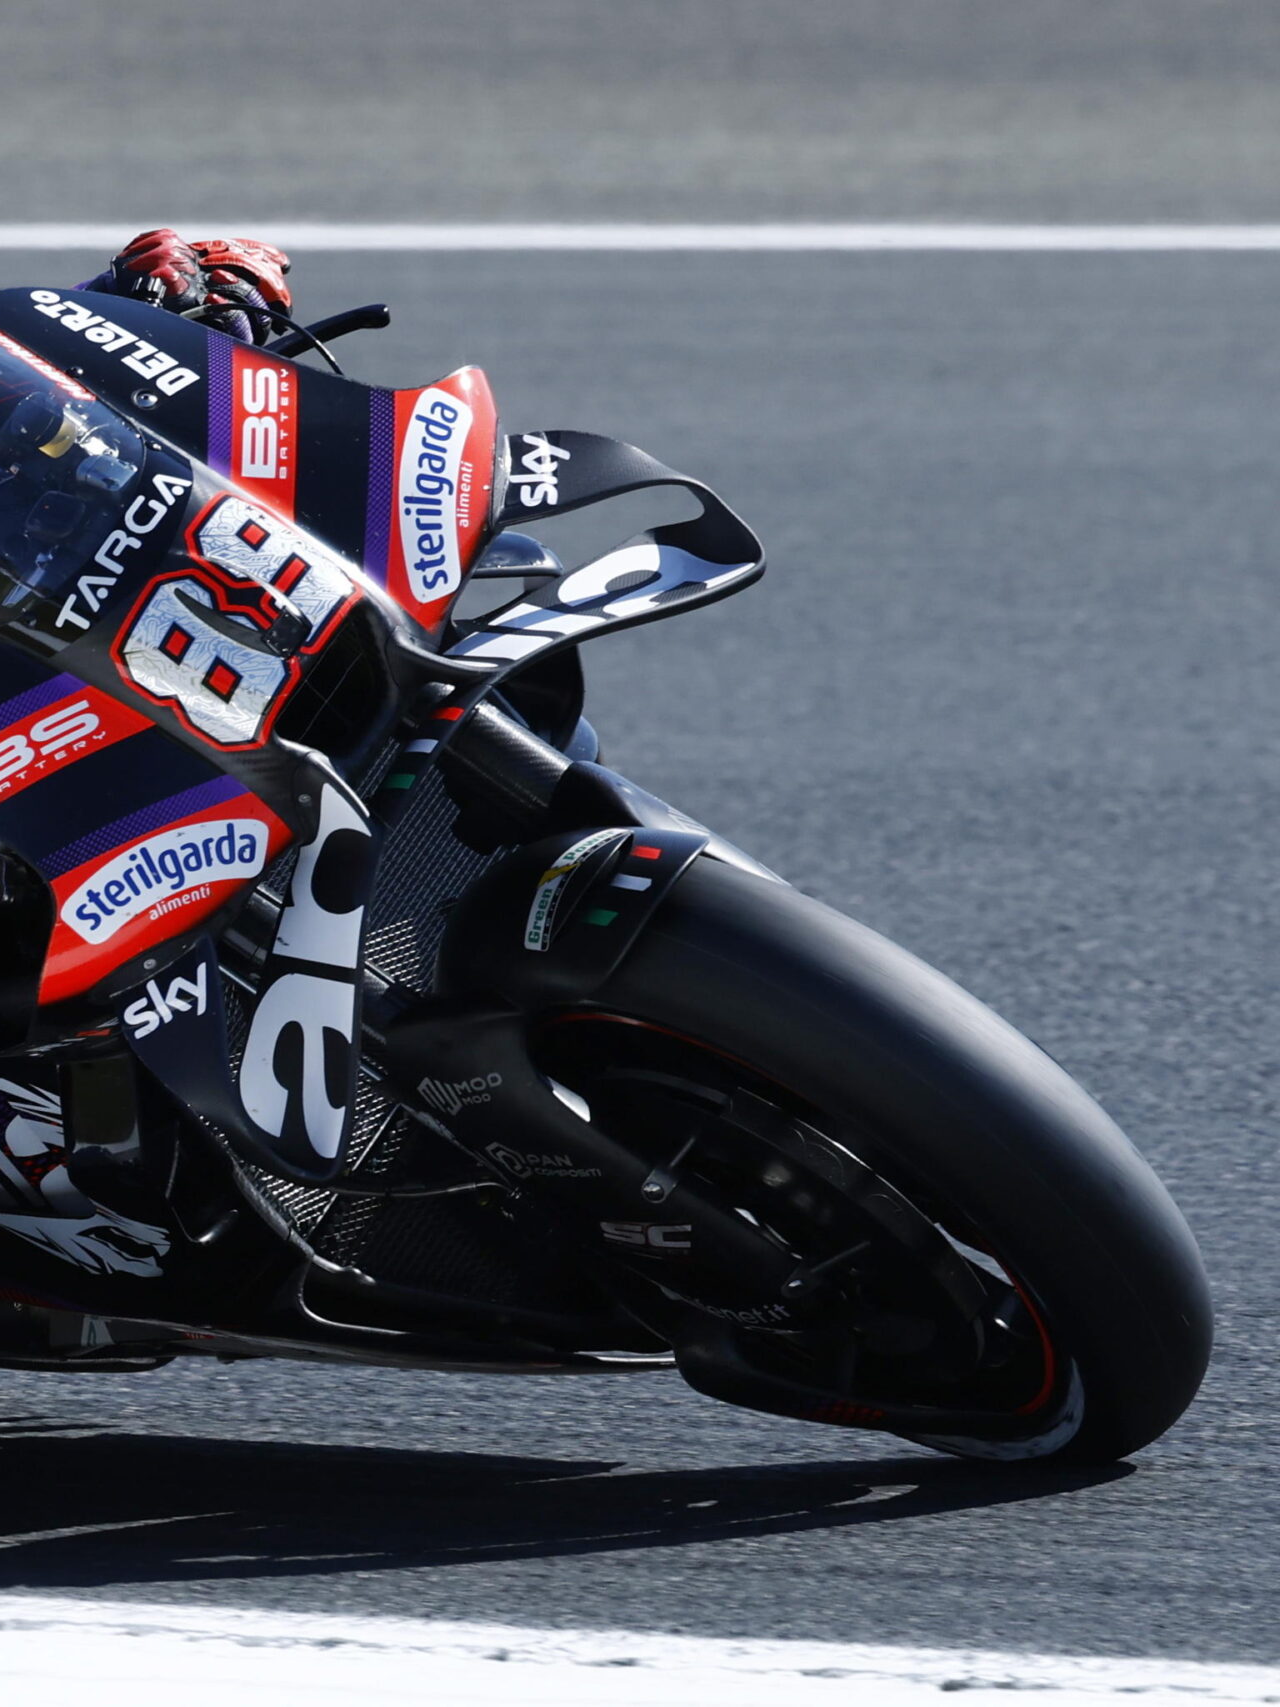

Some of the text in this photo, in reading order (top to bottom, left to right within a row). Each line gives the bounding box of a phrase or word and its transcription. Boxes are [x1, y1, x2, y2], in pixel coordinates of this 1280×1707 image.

[30, 290, 200, 397] DELLORTO
[241, 367, 278, 479] BS
[279, 368, 290, 480] BATTERY
[509, 431, 571, 508] sky
[404, 400, 459, 591] sterilgarda
[458, 461, 474, 528] alimenti
[55, 473, 192, 631] TARGA
[112, 490, 363, 752] 89
[75, 822, 258, 932] sterilgarda
[148, 883, 212, 921] alimenti
[527, 888, 553, 944] Green
[123, 961, 208, 1040] sky
[522, 1153, 573, 1167] PAN
[599, 1221, 693, 1249] SC
